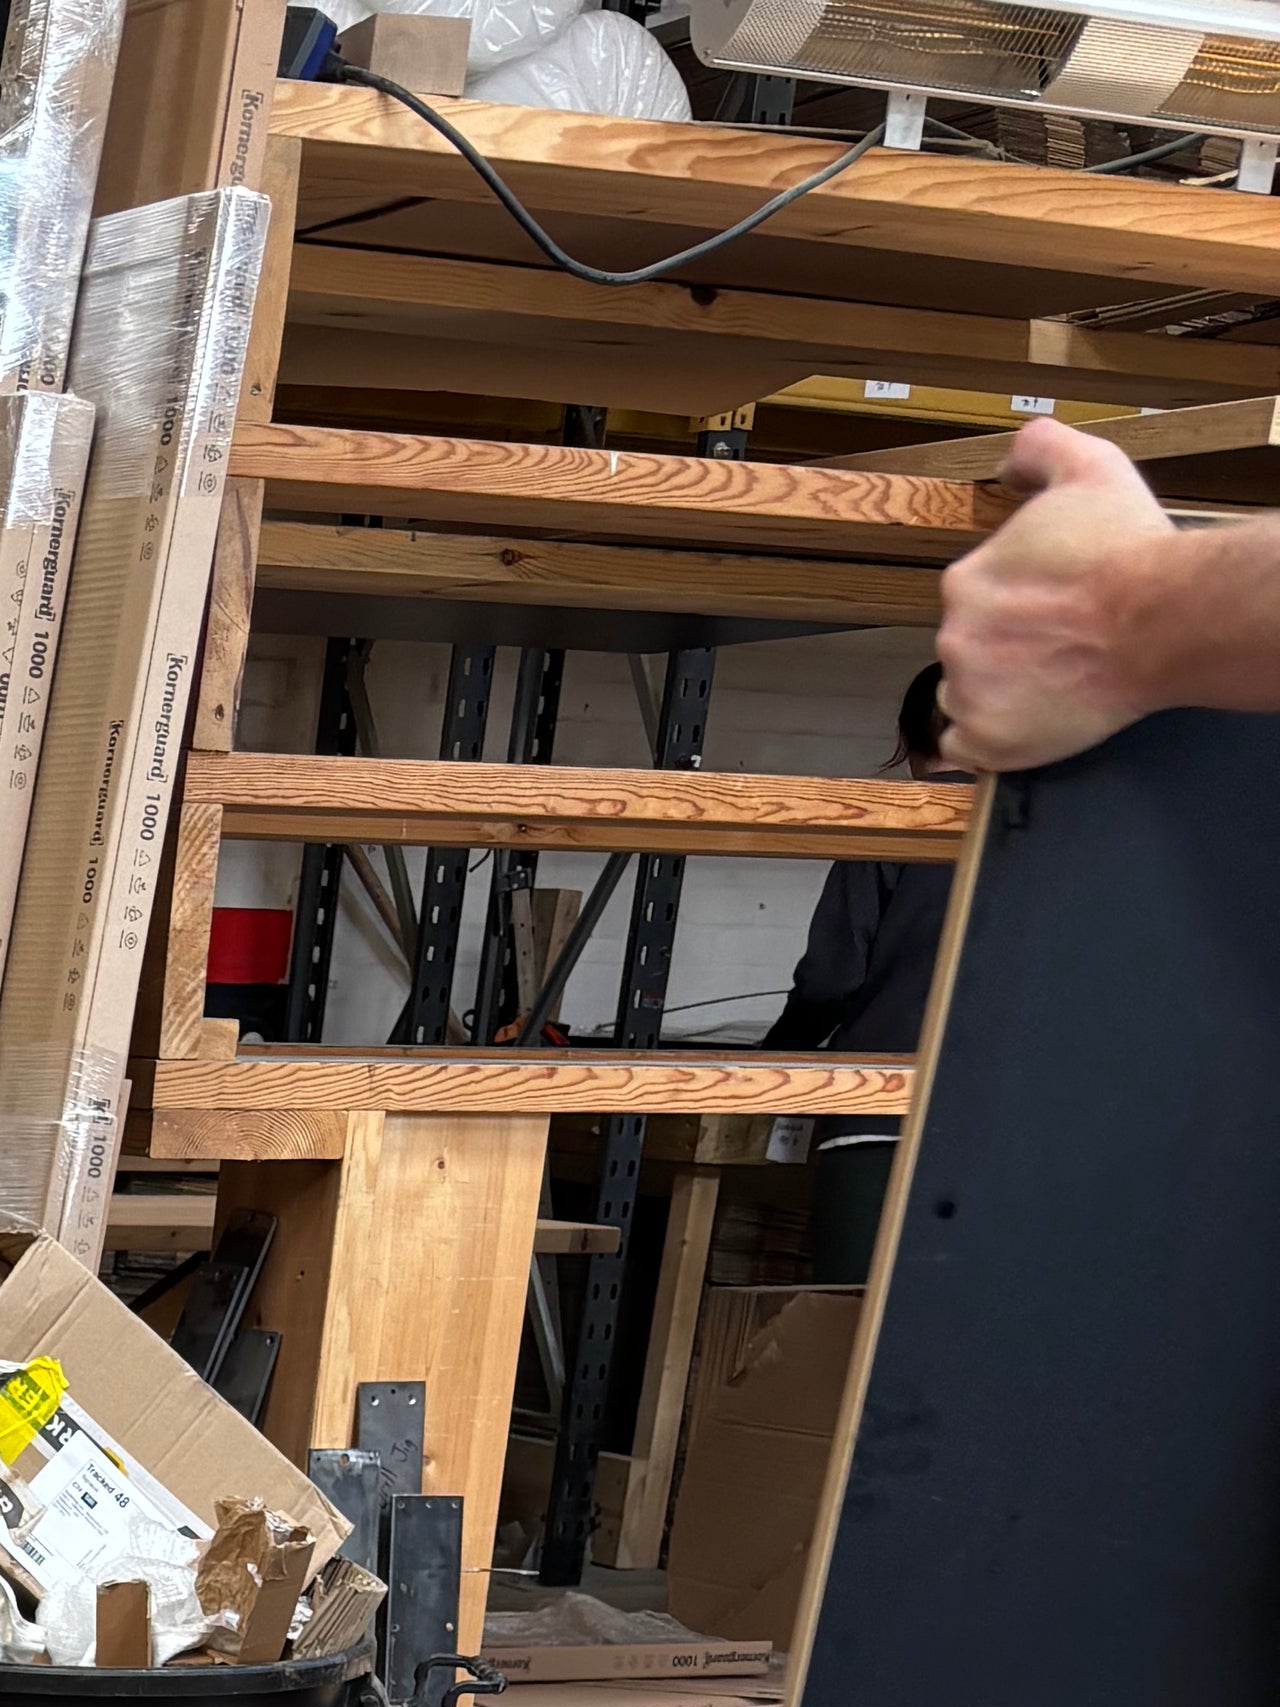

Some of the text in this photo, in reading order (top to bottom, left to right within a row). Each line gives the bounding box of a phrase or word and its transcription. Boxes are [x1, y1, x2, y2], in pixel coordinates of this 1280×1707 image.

[229, 89, 263, 189] [Kornergu
[29, 631, 49, 680] 1000
[140, 793, 161, 842] 1000
[82, 857, 99, 904] 1000
[87, 1134, 108, 1179] 1000
[114, 1493, 130, 1508] 48
[672, 1654, 698, 1668] 1000
